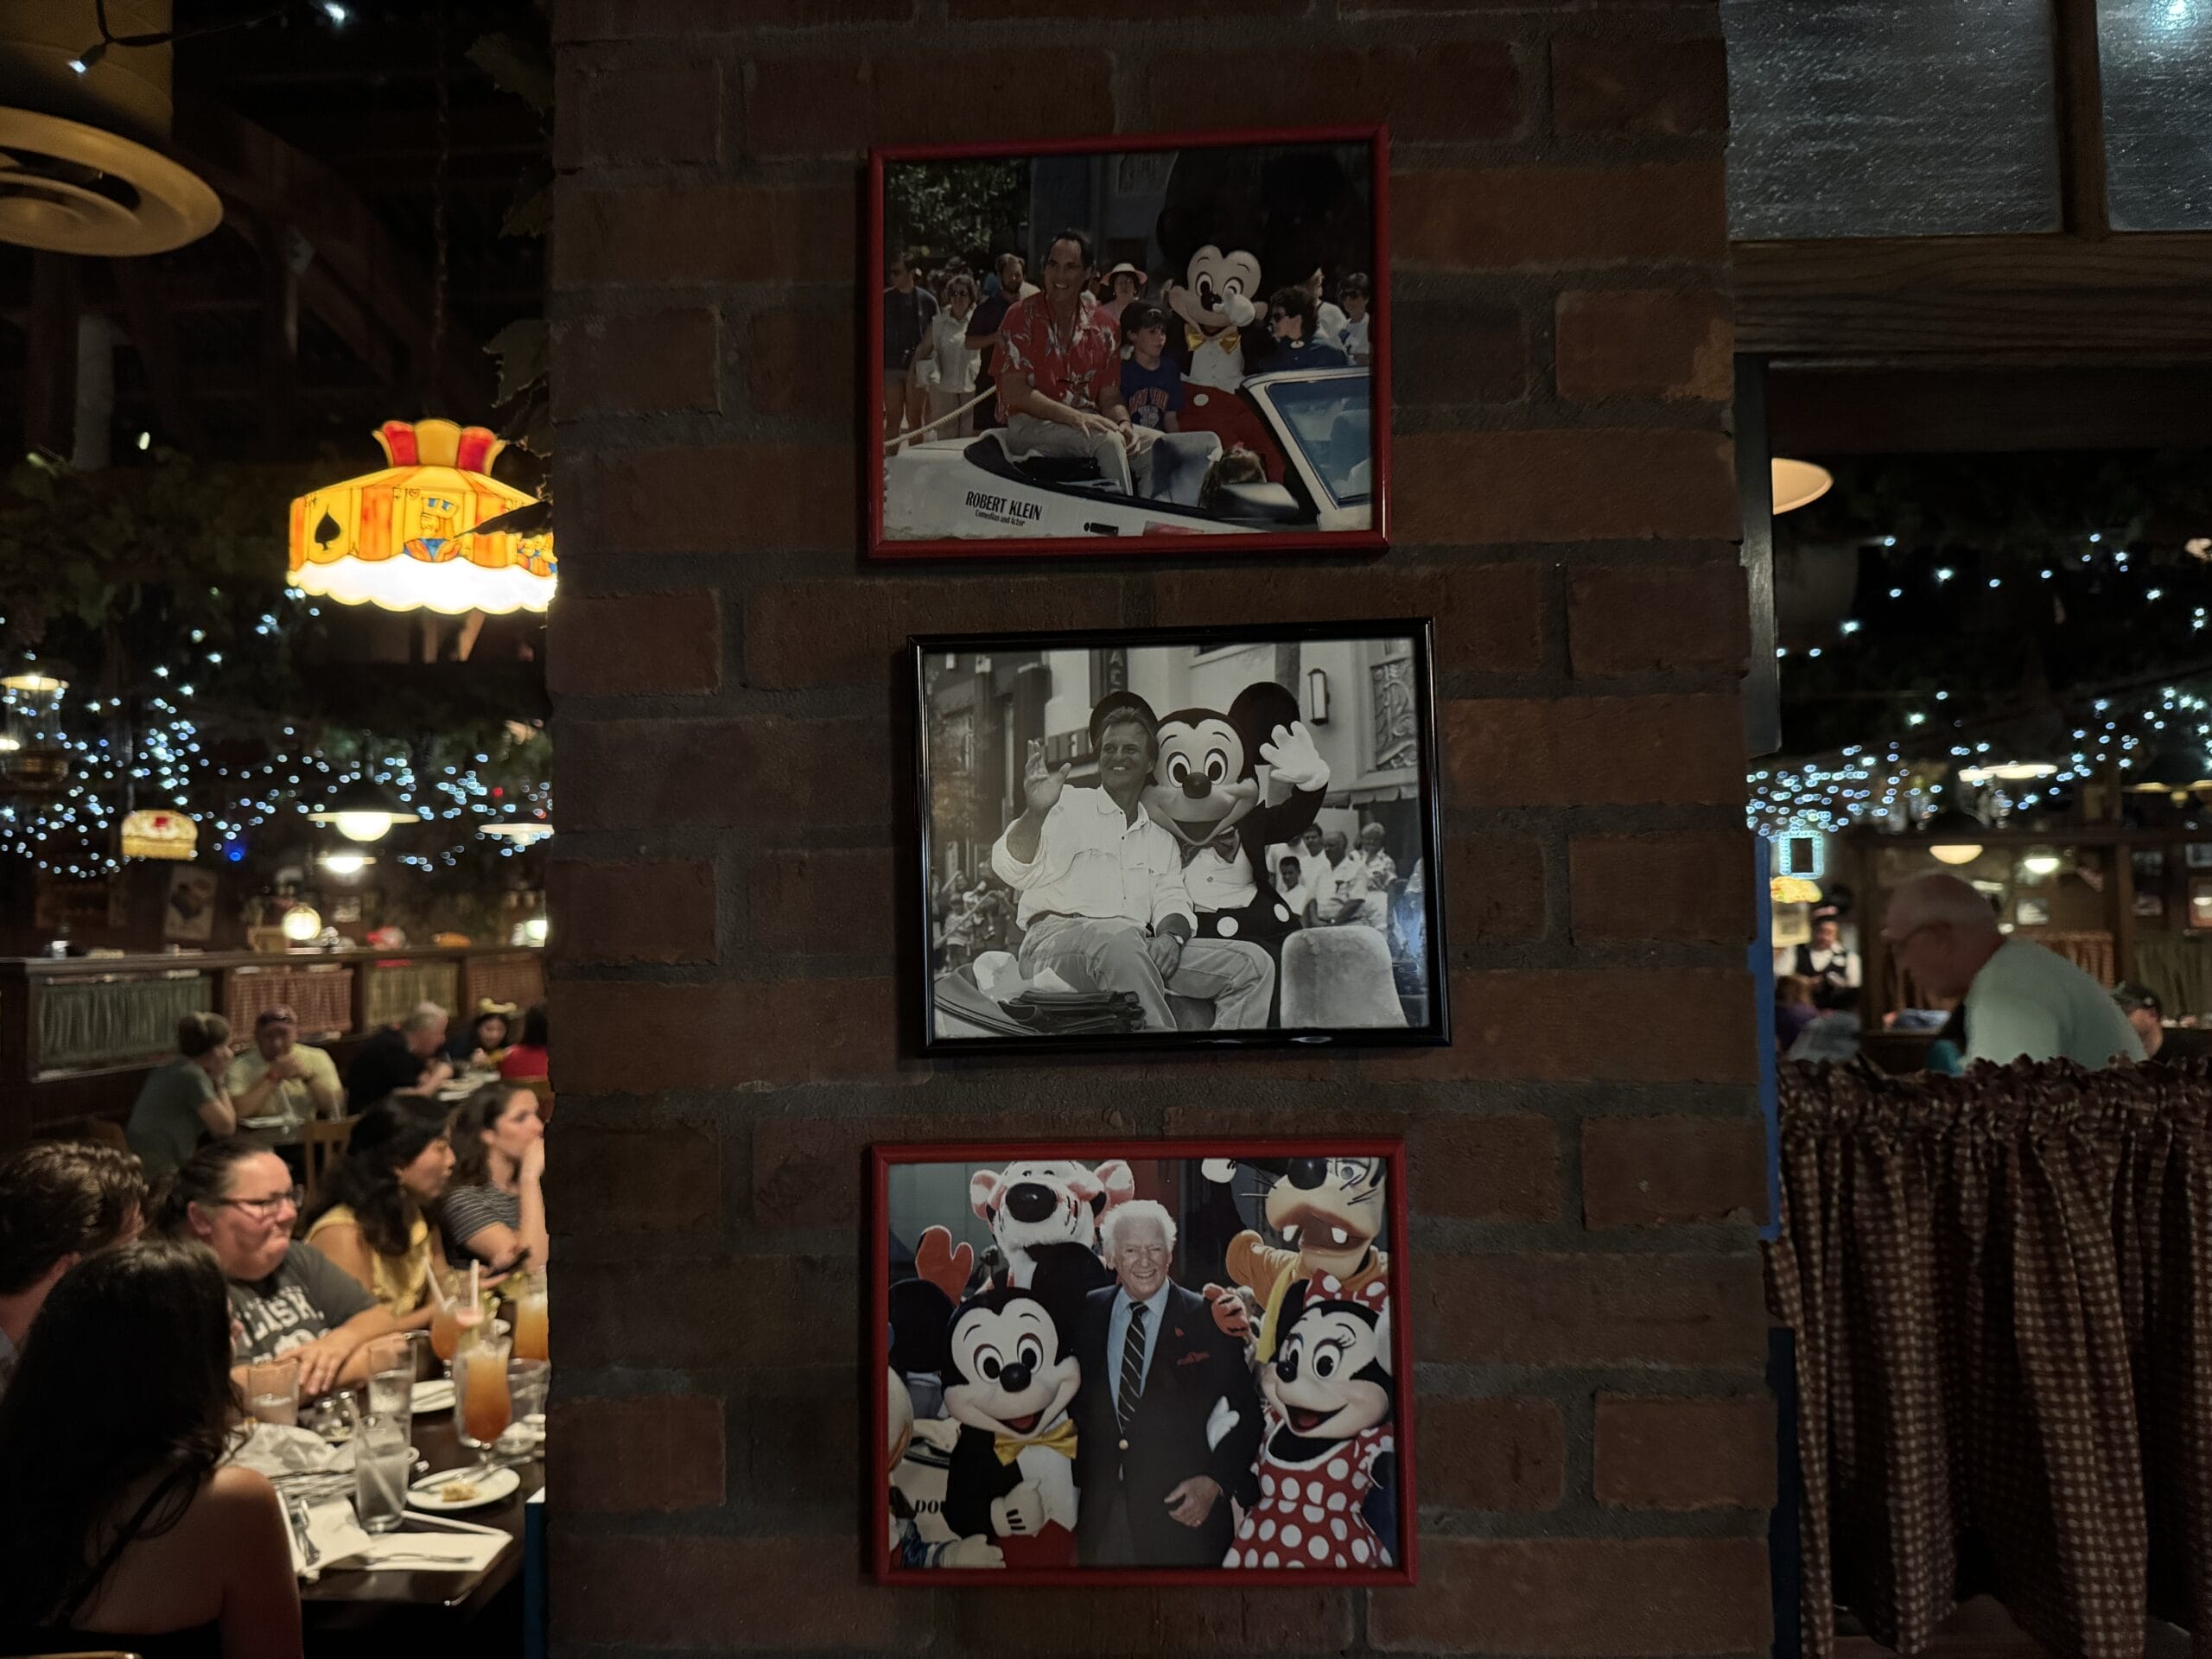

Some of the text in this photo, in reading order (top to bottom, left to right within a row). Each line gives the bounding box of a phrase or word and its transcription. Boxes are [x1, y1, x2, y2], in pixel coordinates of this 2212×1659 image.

[965, 491, 1043, 520] ROBERT KLEIN
[975, 509, 1026, 527] Comedian and Actor
